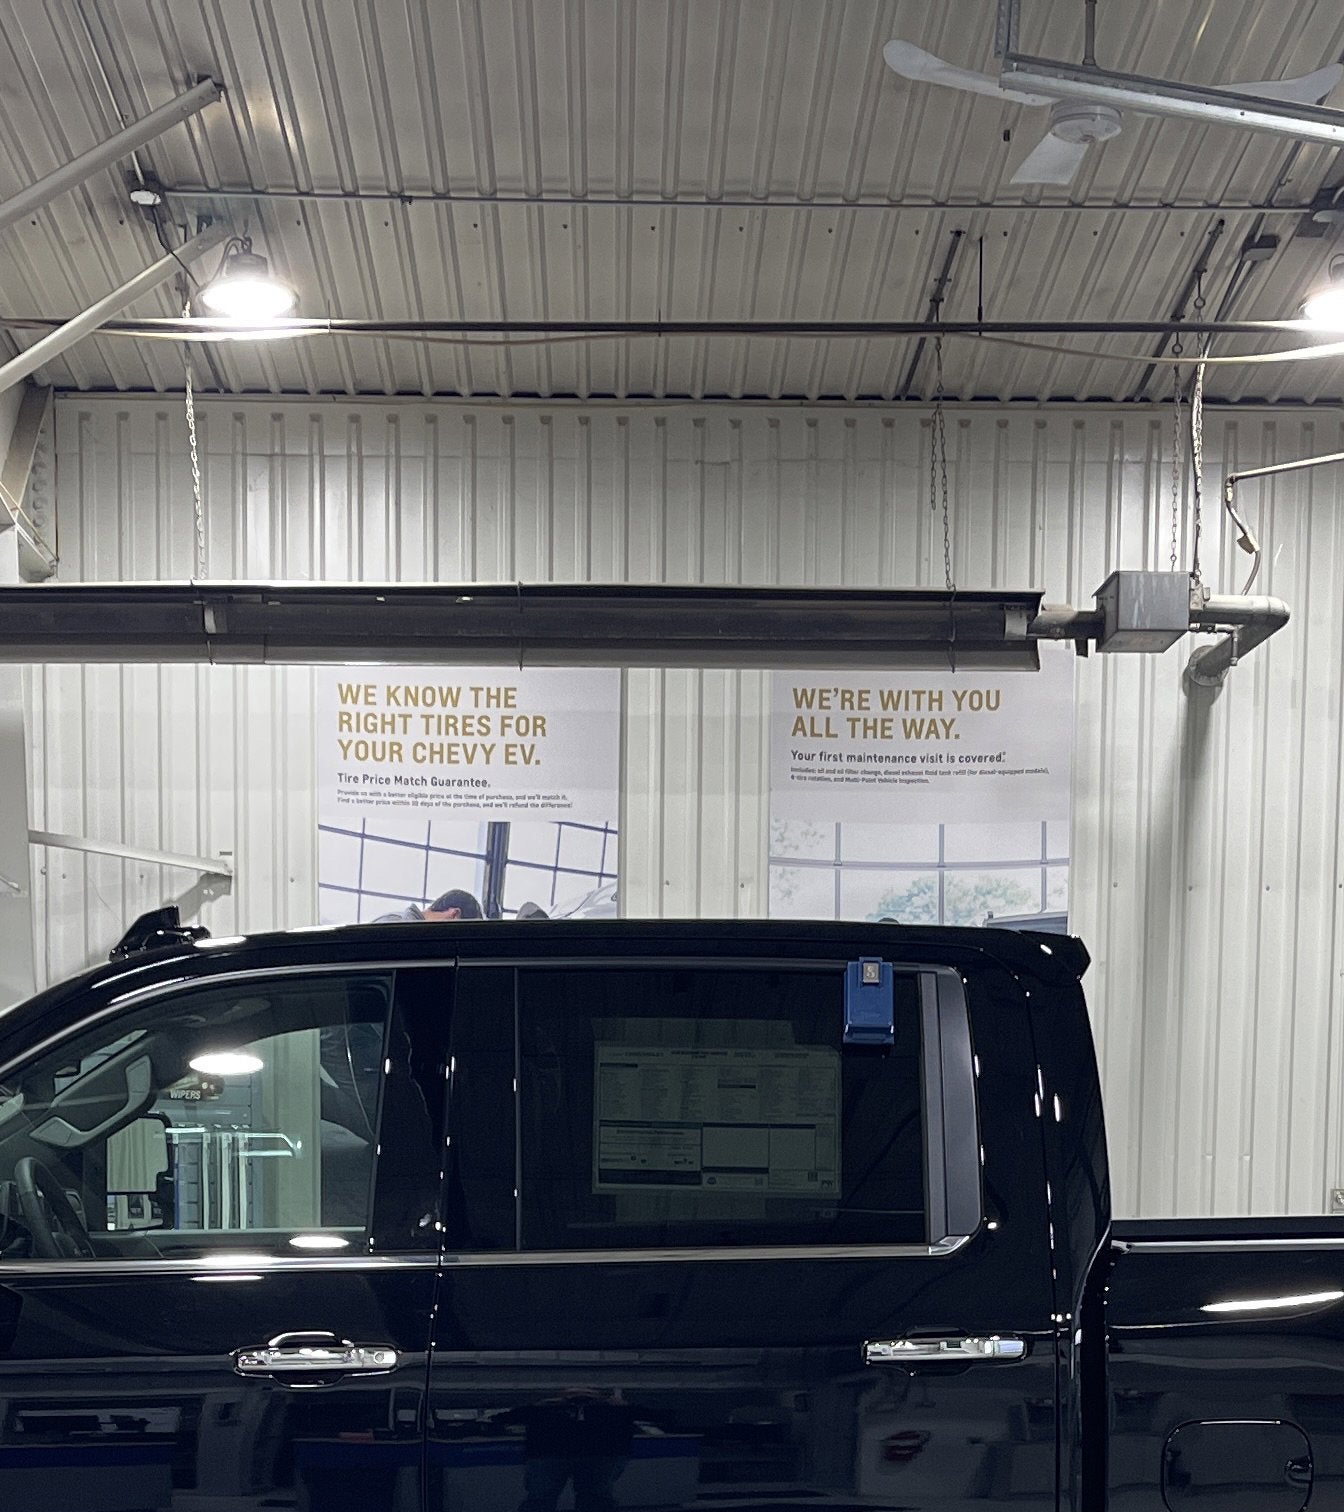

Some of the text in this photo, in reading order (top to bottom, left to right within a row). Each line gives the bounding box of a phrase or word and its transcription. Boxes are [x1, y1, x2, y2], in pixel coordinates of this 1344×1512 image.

[337, 683, 518, 709] WE KNOW THE
[791, 687, 1000, 712] WE'RE WITH YOU
[338, 711, 546, 737] RIGHT TIRES FOR
[791, 715, 960, 741] ALL THE WAY.
[335, 738, 543, 766] YOUR CHEVY EV.
[789, 749, 817, 761] Your
[818, 751, 844, 762] first
[846, 753, 917, 763] maintenance
[919, 753, 944, 763] visit
[946, 752, 956, 763] is
[335, 772, 491, 788] Tire Price Match Guarantee.
[170, 1089, 201, 1100] WIPERS
